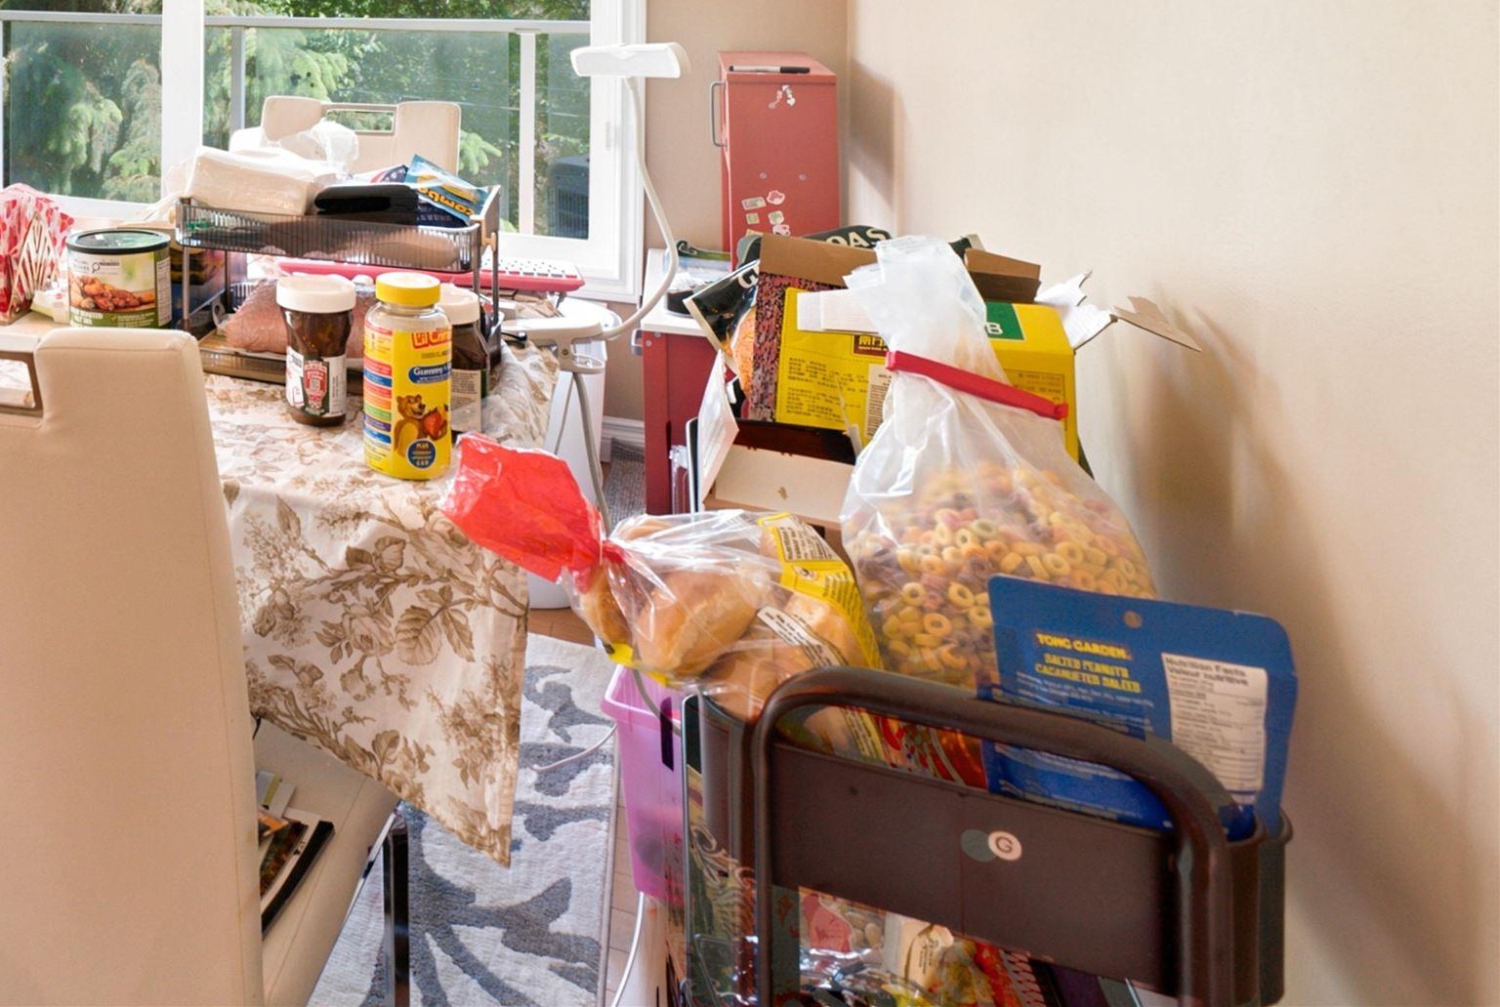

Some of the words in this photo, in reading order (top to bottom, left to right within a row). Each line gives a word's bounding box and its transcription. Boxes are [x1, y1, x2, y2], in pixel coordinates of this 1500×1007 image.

[1036, 633, 1072, 650] TONG
[1072, 639, 1127, 659] GARDEN
[995, 836, 1013, 854] G
